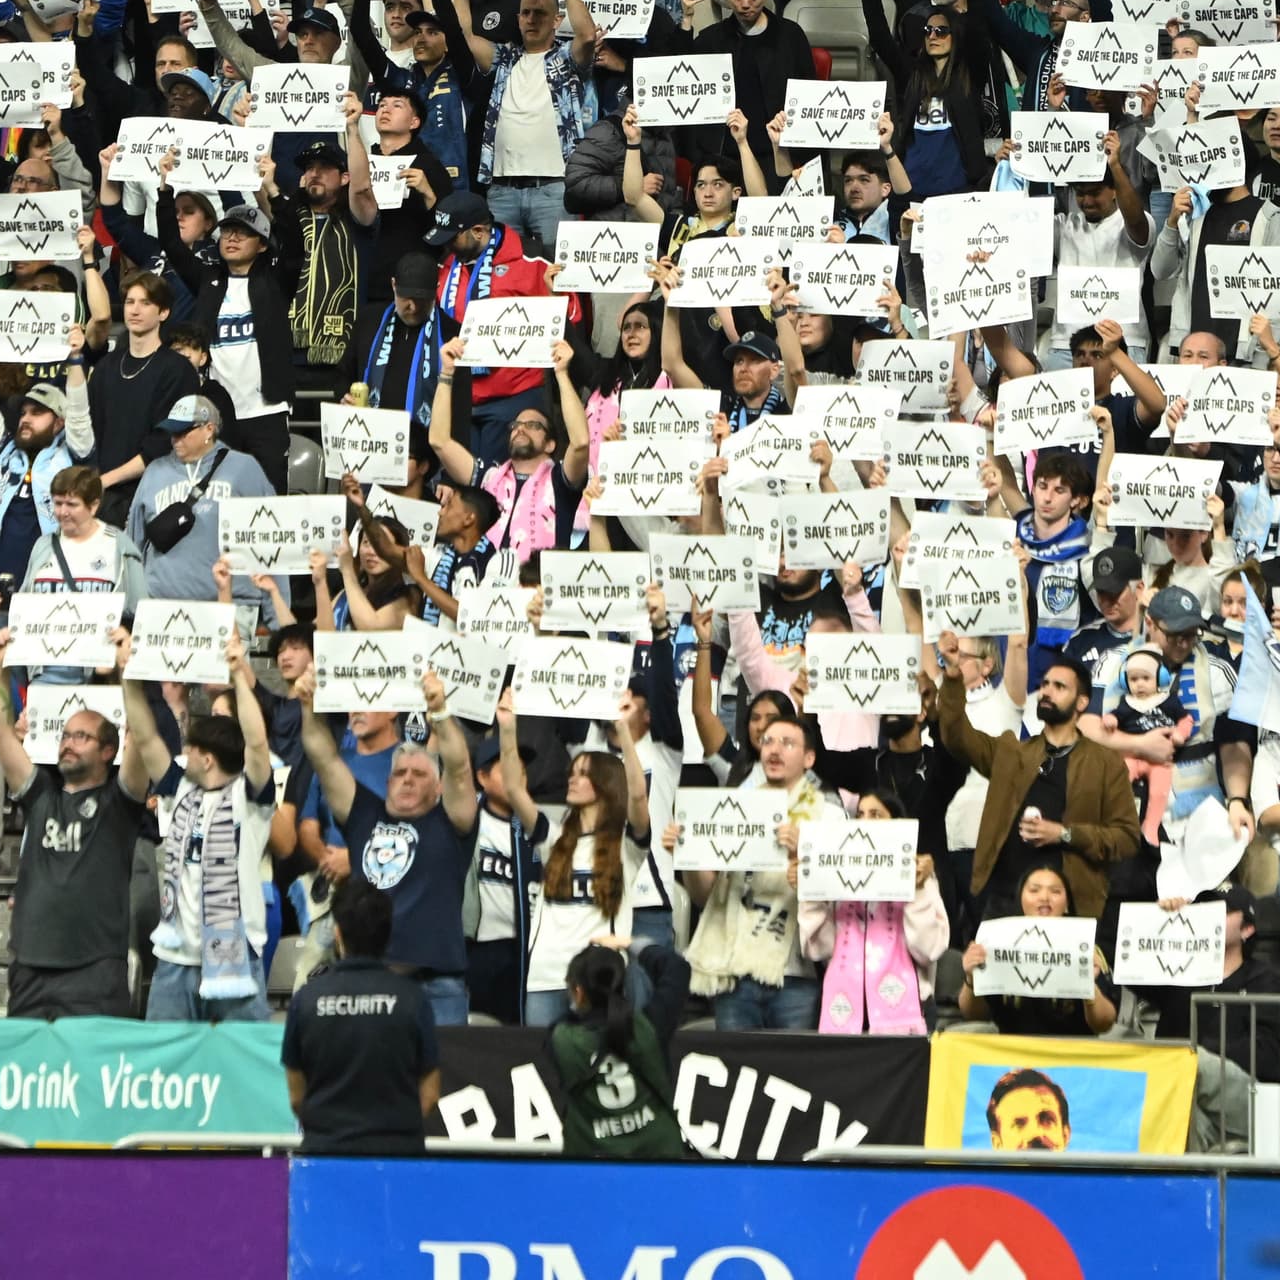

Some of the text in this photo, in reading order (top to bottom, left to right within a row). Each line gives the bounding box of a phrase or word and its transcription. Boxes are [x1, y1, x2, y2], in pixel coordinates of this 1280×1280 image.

[651, 84, 674, 97] SAVE
[690, 82, 716, 96] CAPS
[573, 250, 596, 263] SAVE
[613, 250, 638, 264] CAPS
[807, 271, 831, 284] SAVE
[849, 273, 875, 286] CAPS
[1224, 275, 1245, 289] SAVE
[219, 322, 254, 338] ELU
[25, 364, 68, 379] ELU
[897, 452, 922, 466] SAVE
[941, 454, 969, 468] CAPS
[155, 480, 232, 515] VANCVER
[42, 817, 82, 853] Bell
[692, 822, 716, 836] SAVE
[736, 823, 765, 837] CAPS
[992, 948, 1020, 964] SAVE
[1041, 950, 1071, 967] CAPS
[316, 994, 397, 1016] SECURITY
[591, 1052, 637, 1109] 3
[0, 1061, 80, 1118] Drink
[101, 1052, 221, 1127] Victory
[673, 1052, 870, 1160] CITY
[594, 1105, 655, 1138] MEDIA
